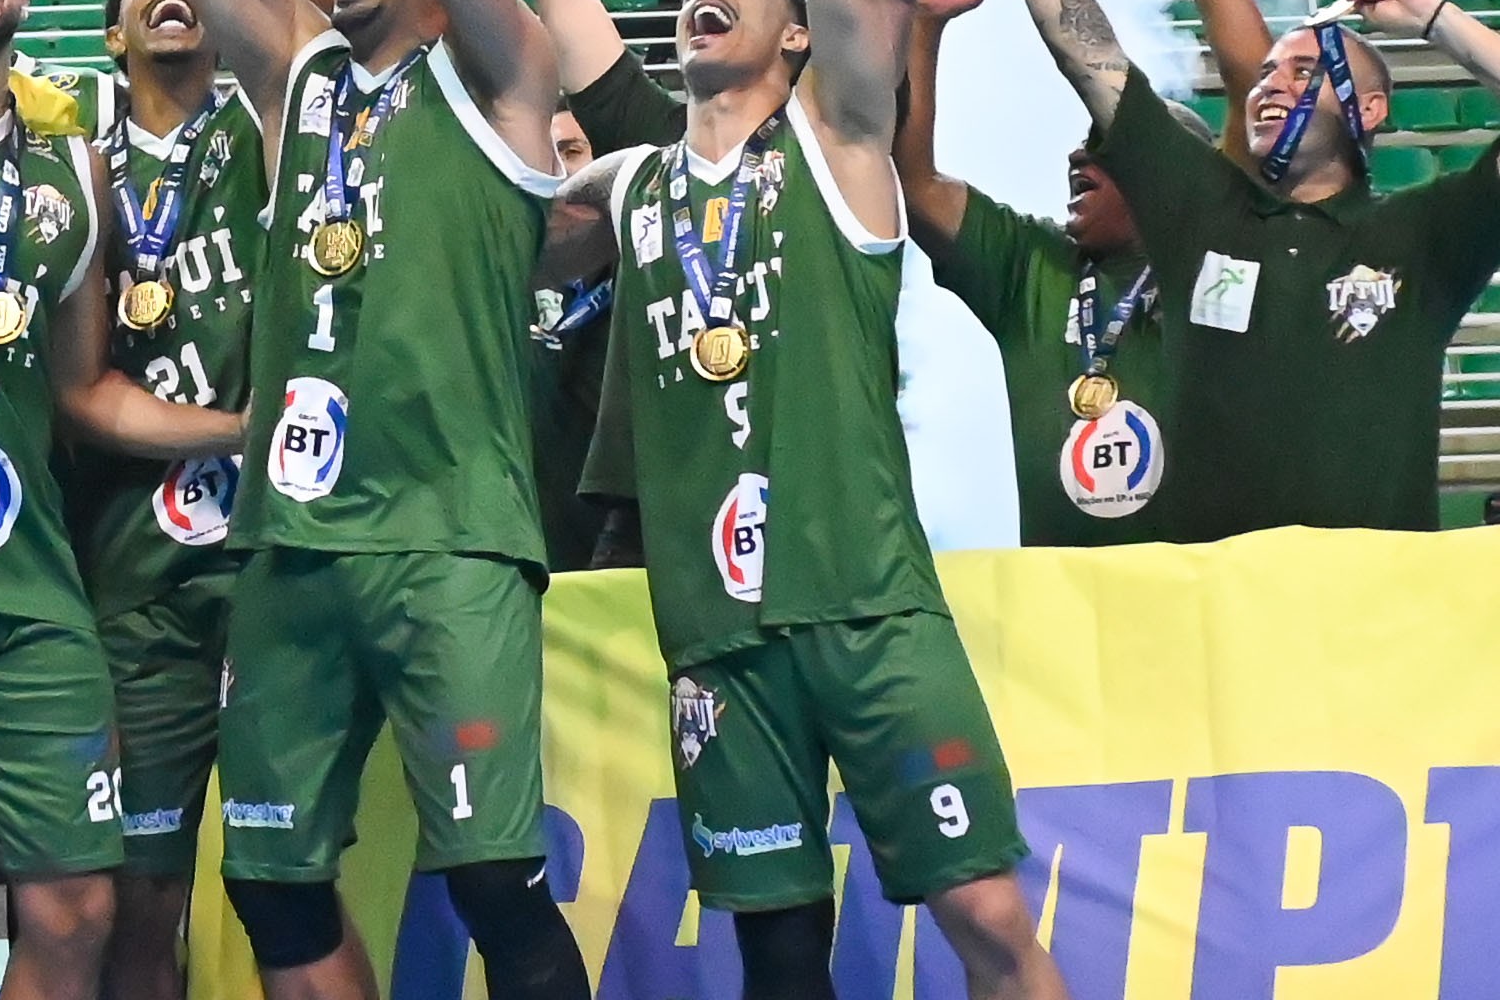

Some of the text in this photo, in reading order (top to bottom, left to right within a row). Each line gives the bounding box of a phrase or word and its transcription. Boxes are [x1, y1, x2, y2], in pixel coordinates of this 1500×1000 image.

[308, 285, 336, 352] 1
[145, 341, 217, 406] 21
[284, 423, 330, 457] BT
[1093, 441, 1132, 469] BT
[183, 470, 219, 505] BT
[451, 763, 473, 819] 1
[929, 783, 971, 839] 9
